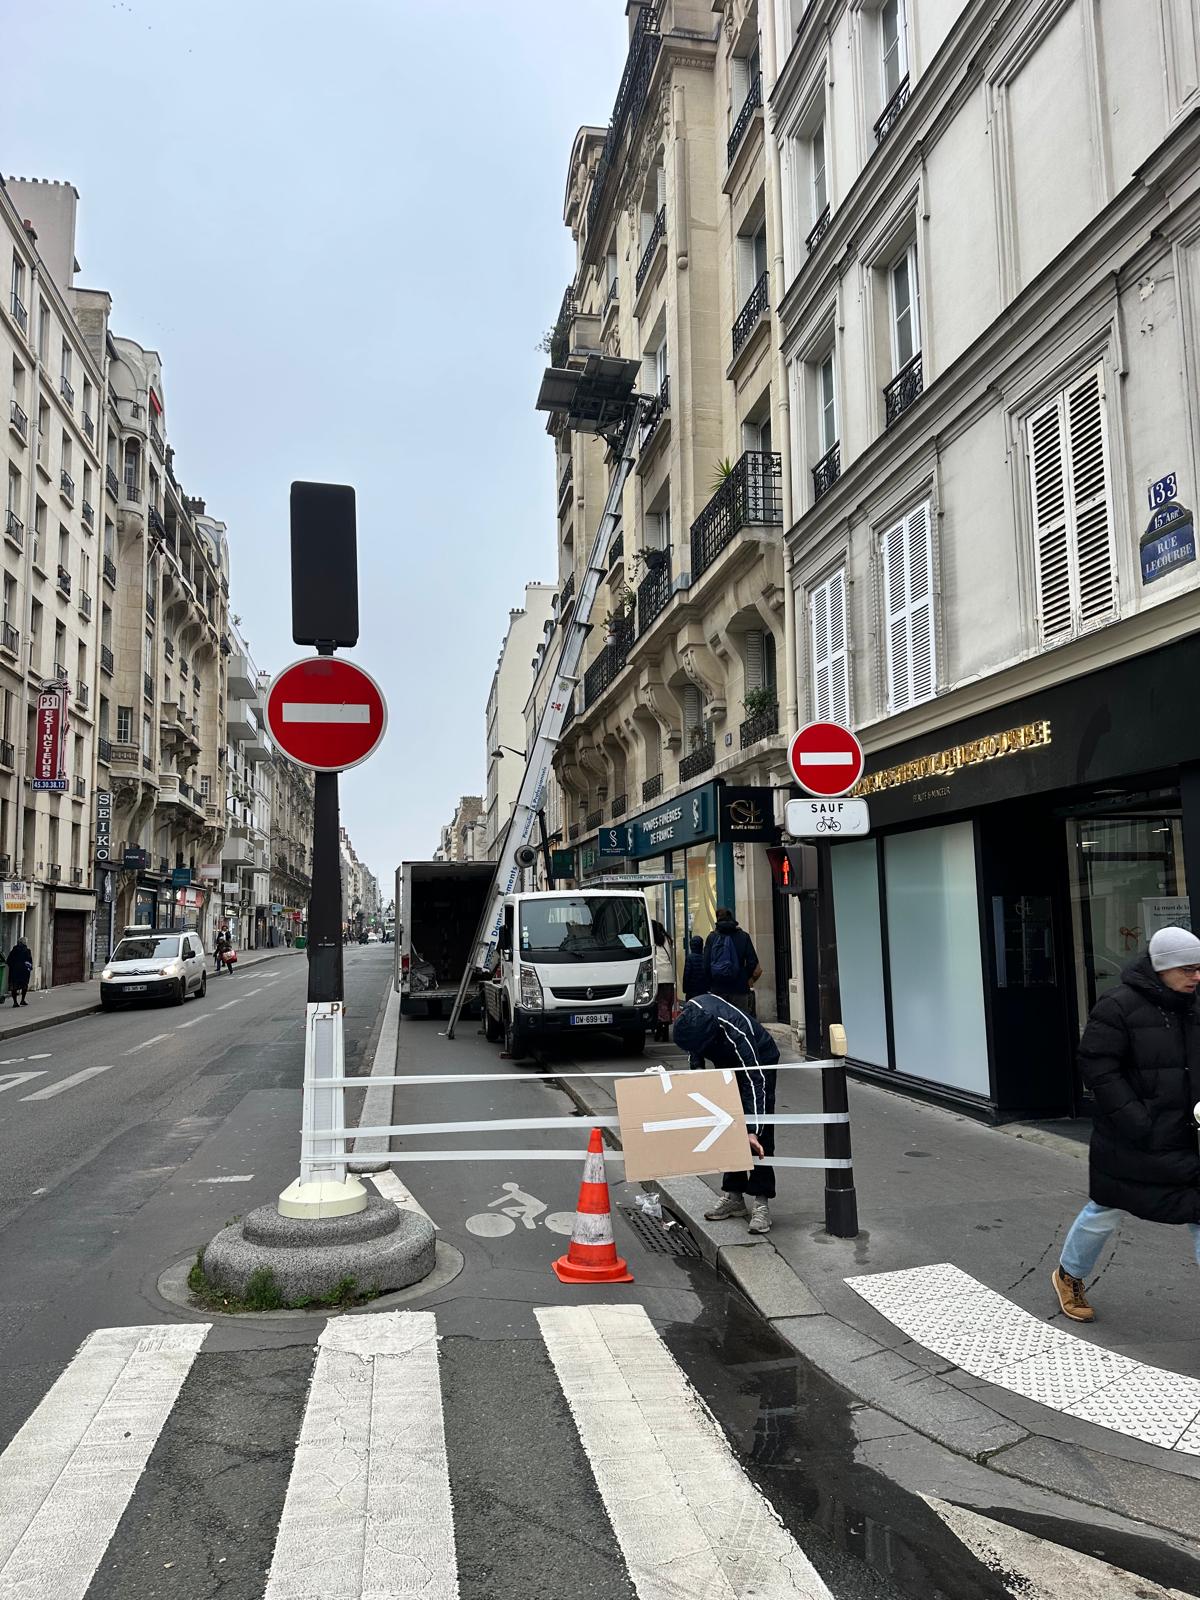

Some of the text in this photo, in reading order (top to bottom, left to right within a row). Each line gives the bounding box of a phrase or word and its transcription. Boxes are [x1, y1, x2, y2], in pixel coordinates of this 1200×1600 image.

[1150, 474, 1177, 508] 133
[1157, 536, 1178, 554] RUE
[1145, 543, 1193, 573] LECOURBE
[42, 697, 58, 707] PSI
[42, 710, 54, 777] EXTINCTEURS
[34, 780, 65, 789] 45.30.38.12
[811, 803, 844, 813] SAUF
[97, 795, 110, 860] SEIKO
[650, 826, 674, 845] DE FRANCE
